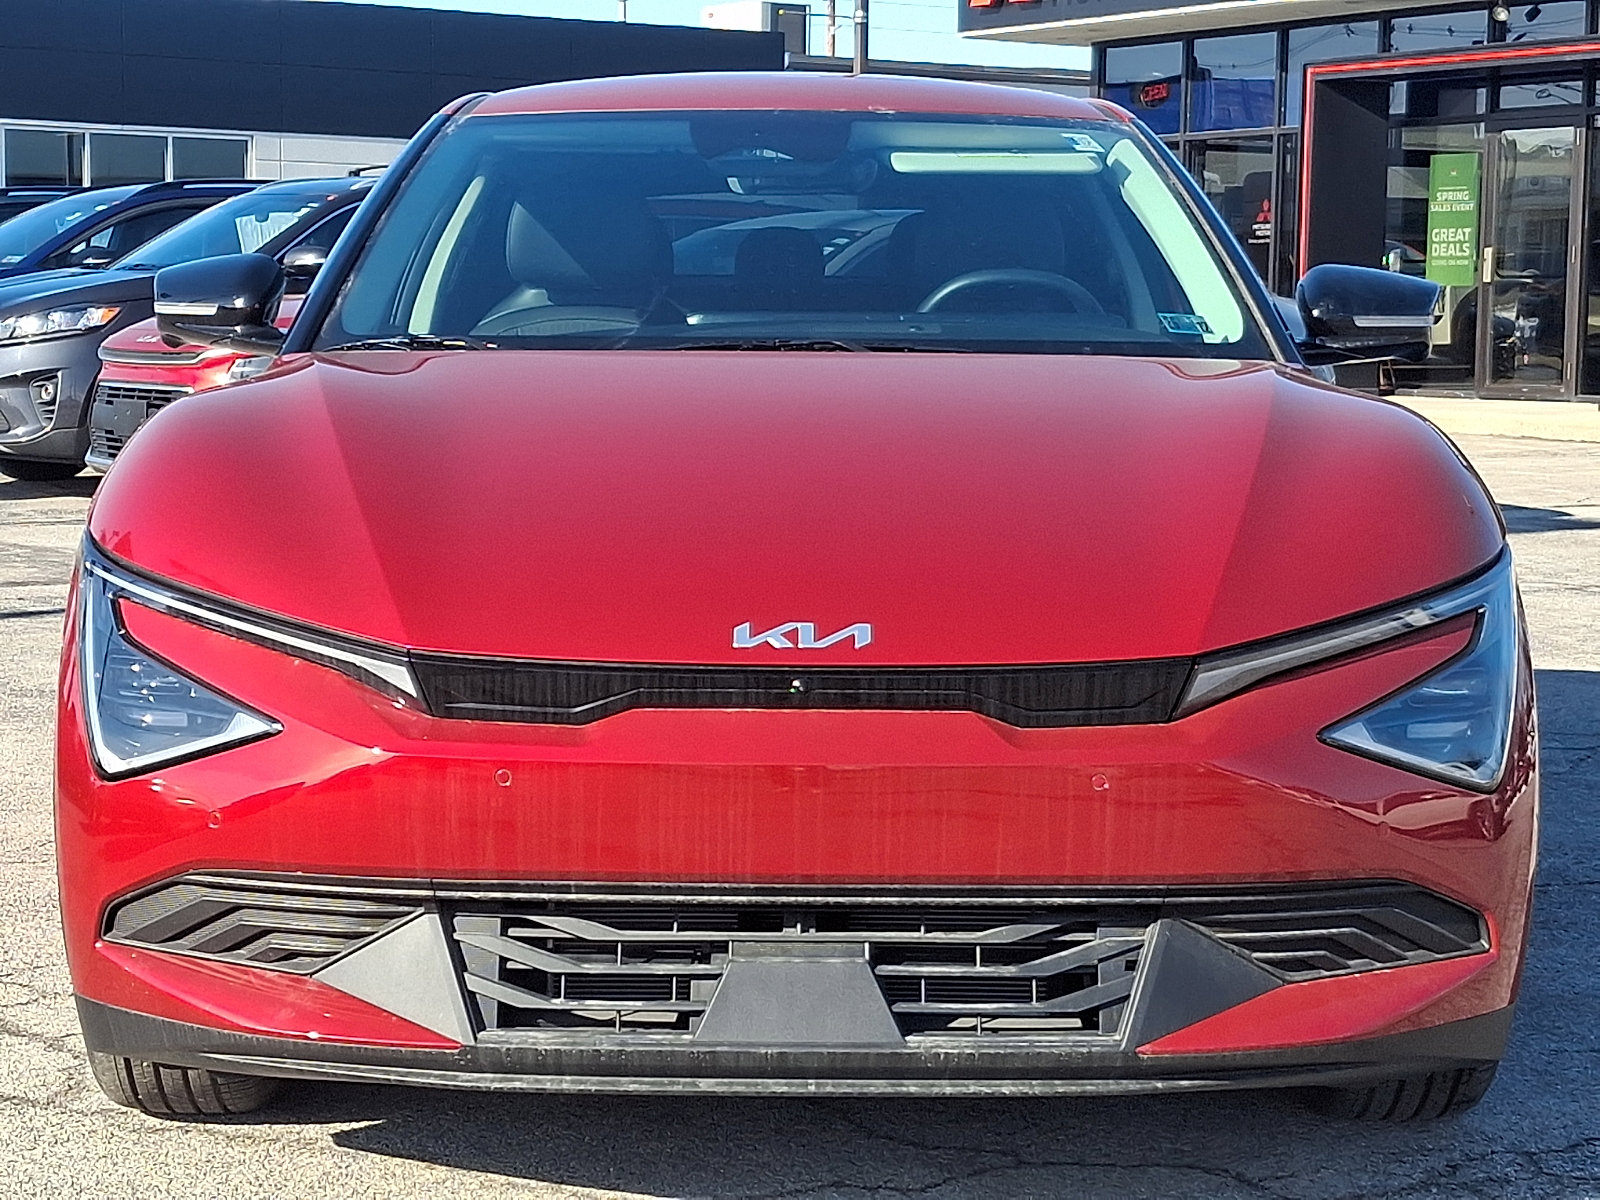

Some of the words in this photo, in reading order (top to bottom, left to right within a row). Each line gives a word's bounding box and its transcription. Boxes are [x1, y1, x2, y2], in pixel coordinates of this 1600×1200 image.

[1436, 191, 1469, 201] SPRING
[1452, 203, 1474, 211] EVENT
[1431, 228, 1471, 242] GREAT
[1431, 243, 1470, 256] DEALS
[732, 621, 872, 649] KIA
